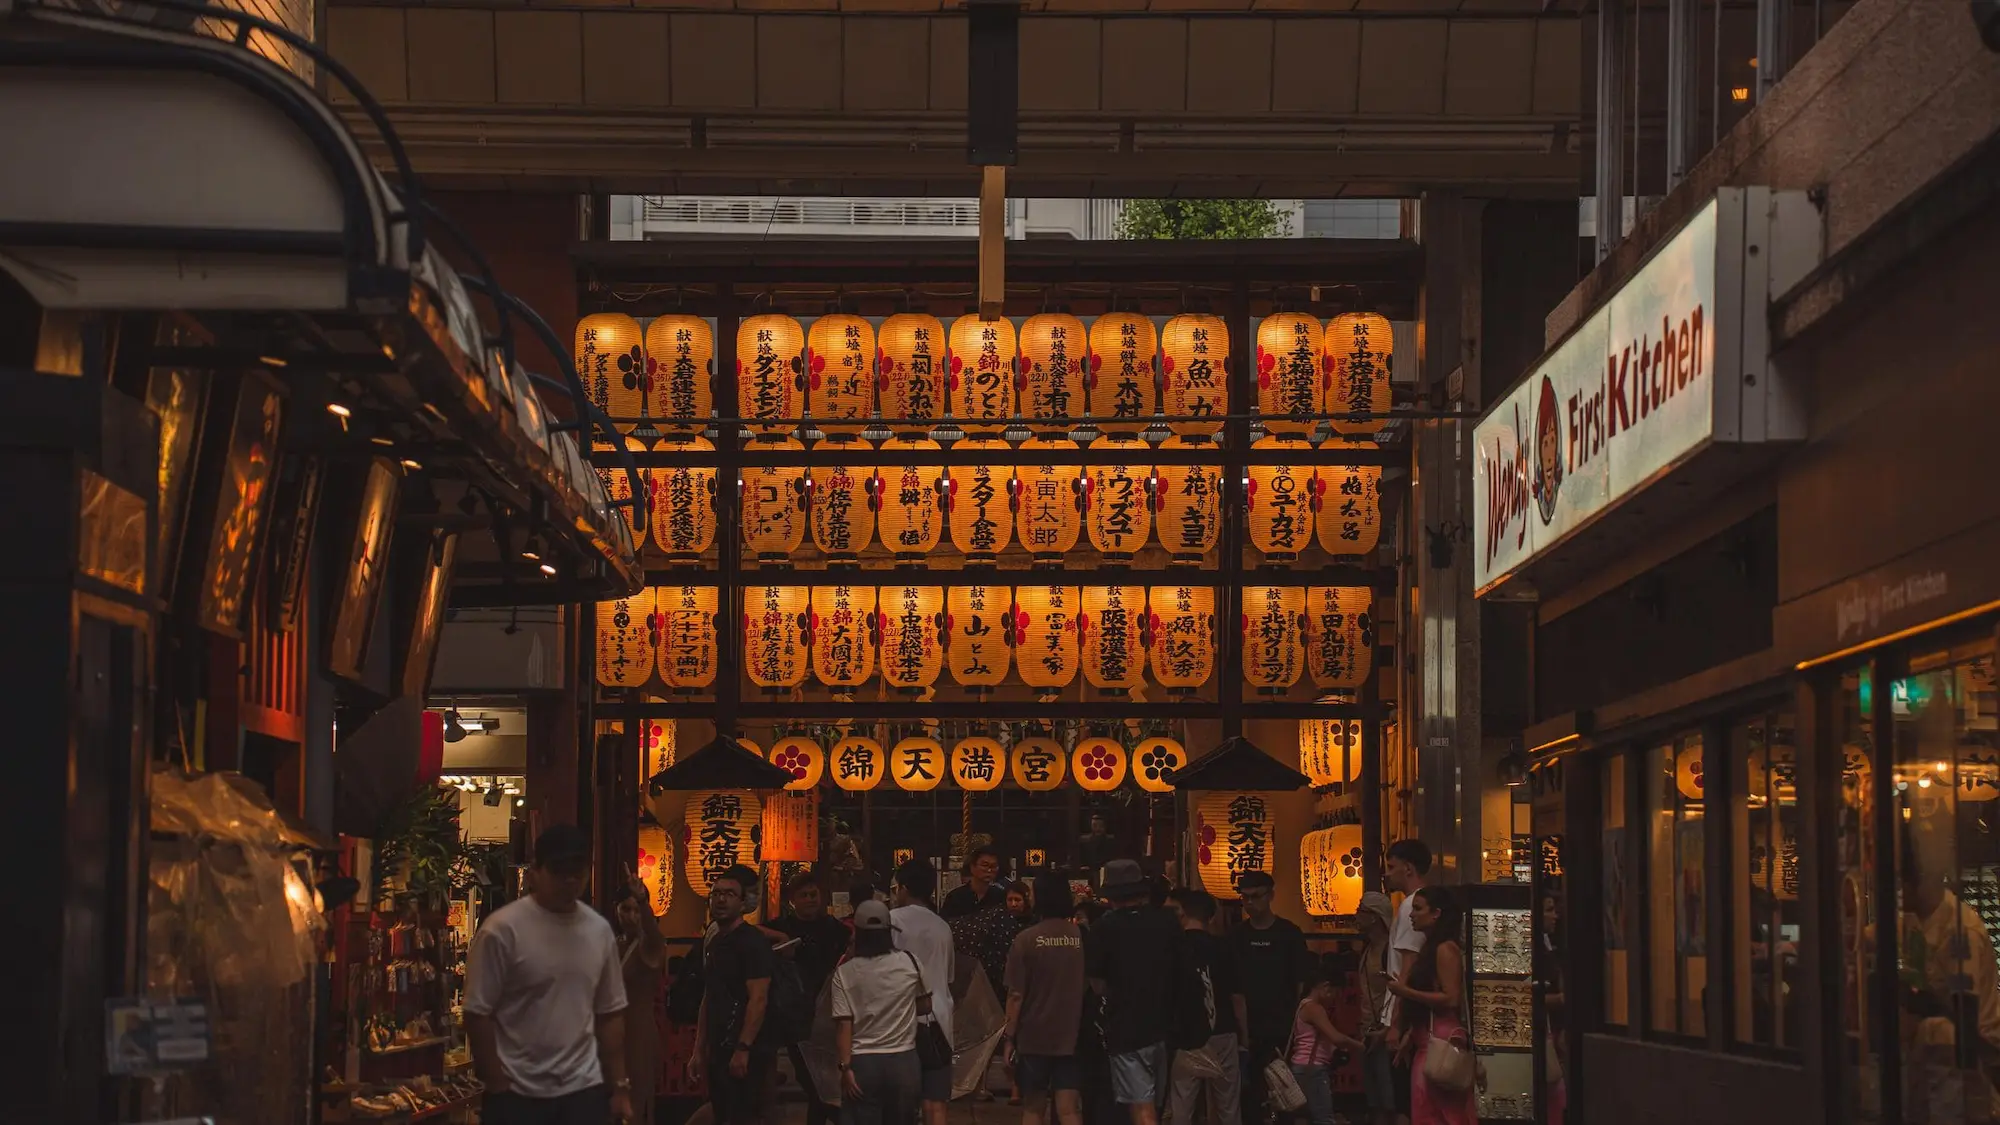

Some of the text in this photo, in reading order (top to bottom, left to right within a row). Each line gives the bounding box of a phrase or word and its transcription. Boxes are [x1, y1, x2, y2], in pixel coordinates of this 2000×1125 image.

[977, 353, 1000, 372] 錦
[1067, 359, 1080, 378] 錦
[753, 354, 778, 431] ダイヤモンド
[1113, 378, 1144, 418] 木村
[1185, 358, 1215, 417] 魚力
[1567, 303, 1703, 477] First Kitchen
[900, 475, 920, 488] 錦
[969, 476, 998, 550] スター食堂
[1034, 478, 1059, 547] 寅太郎
[1105, 474, 1135, 547] ウィズユー
[1296, 491, 1307, 534] 株式会社
[763, 611, 782, 626] 錦
[832, 609, 853, 626] 錦
[963, 615, 991, 675] 山とみ
[1035, 934, 1081, 951] Saturday
